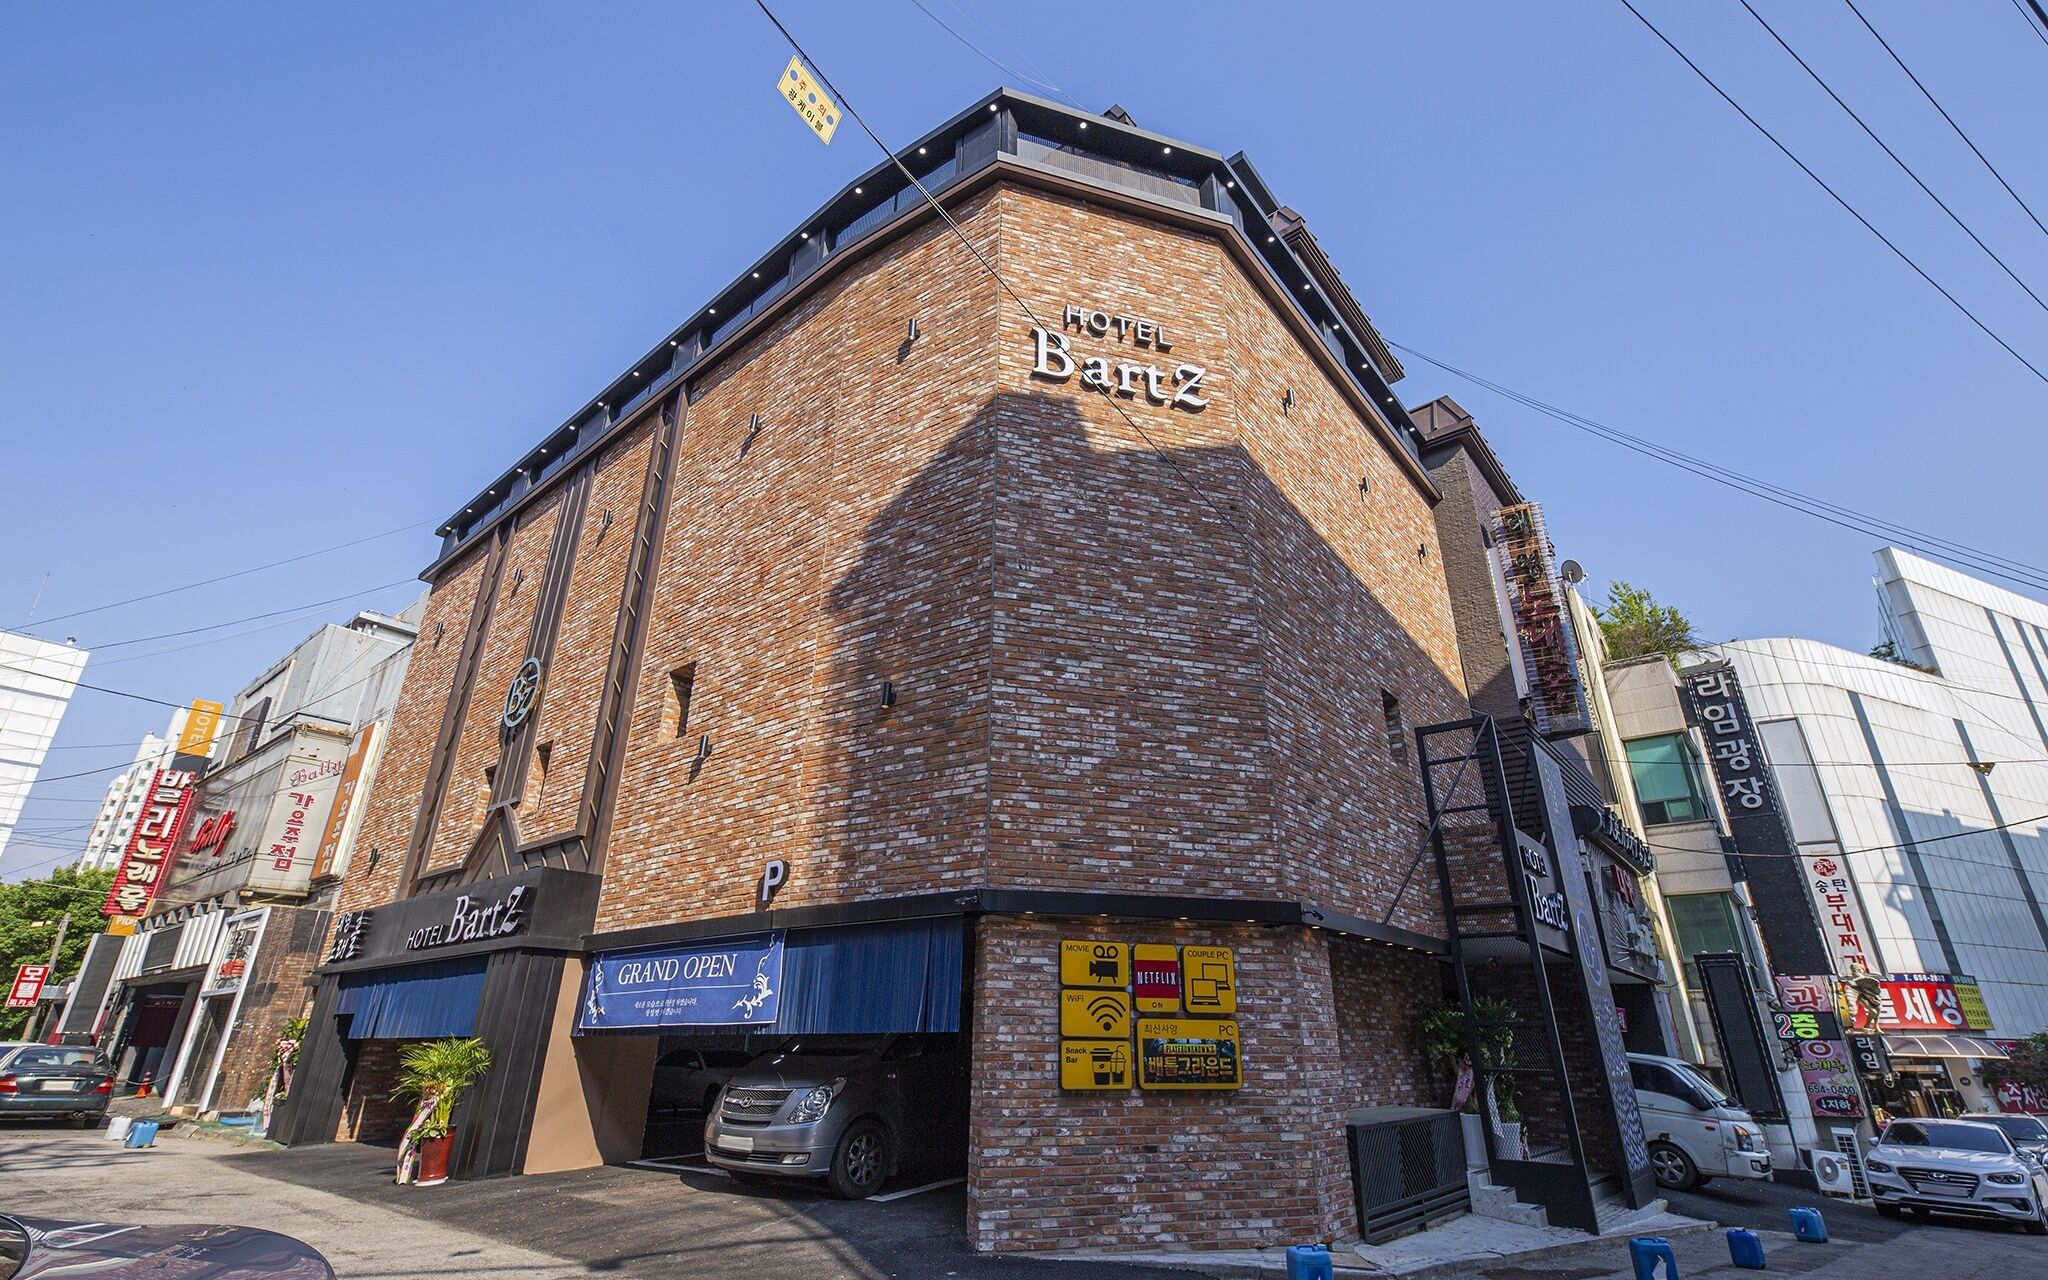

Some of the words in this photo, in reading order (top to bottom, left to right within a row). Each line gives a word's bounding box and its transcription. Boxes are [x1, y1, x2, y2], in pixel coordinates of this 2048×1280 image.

[1065, 304, 1173, 350] HOTEL
[1696, 673, 1764, 809] 라임광장
[762, 859, 785, 901] P
[1815, 879, 1848, 893] 송탄
[405, 924, 444, 950] HOTEL
[1065, 944, 1089, 952] MOVIE
[1187, 950, 1215, 958] COUPLE
[1216, 952, 1229, 960] PC
[618, 958, 679, 985] GRAND
[683, 953, 738, 980] OPEN
[16, 967, 45, 998] 모텔
[1137, 971, 1177, 985] NETFLIX
[1066, 994, 1084, 1002] WiFi
[1151, 1001, 1163, 1009] ON
[1143, 1023, 1178, 1035] 최신사양
[1218, 1025, 1234, 1036] PC
[1775, 1013, 1820, 1038] 2층
[1065, 1046, 1087, 1054] Snack
[1855, 1037, 1880, 1070] 라임
[1065, 1056, 1078, 1064] Bar
[1148, 1056, 1233, 1077] 배틀그라운드
[1807, 1085, 1856, 1095] 654-0400
[1826, 1099, 1852, 1110] 지하
